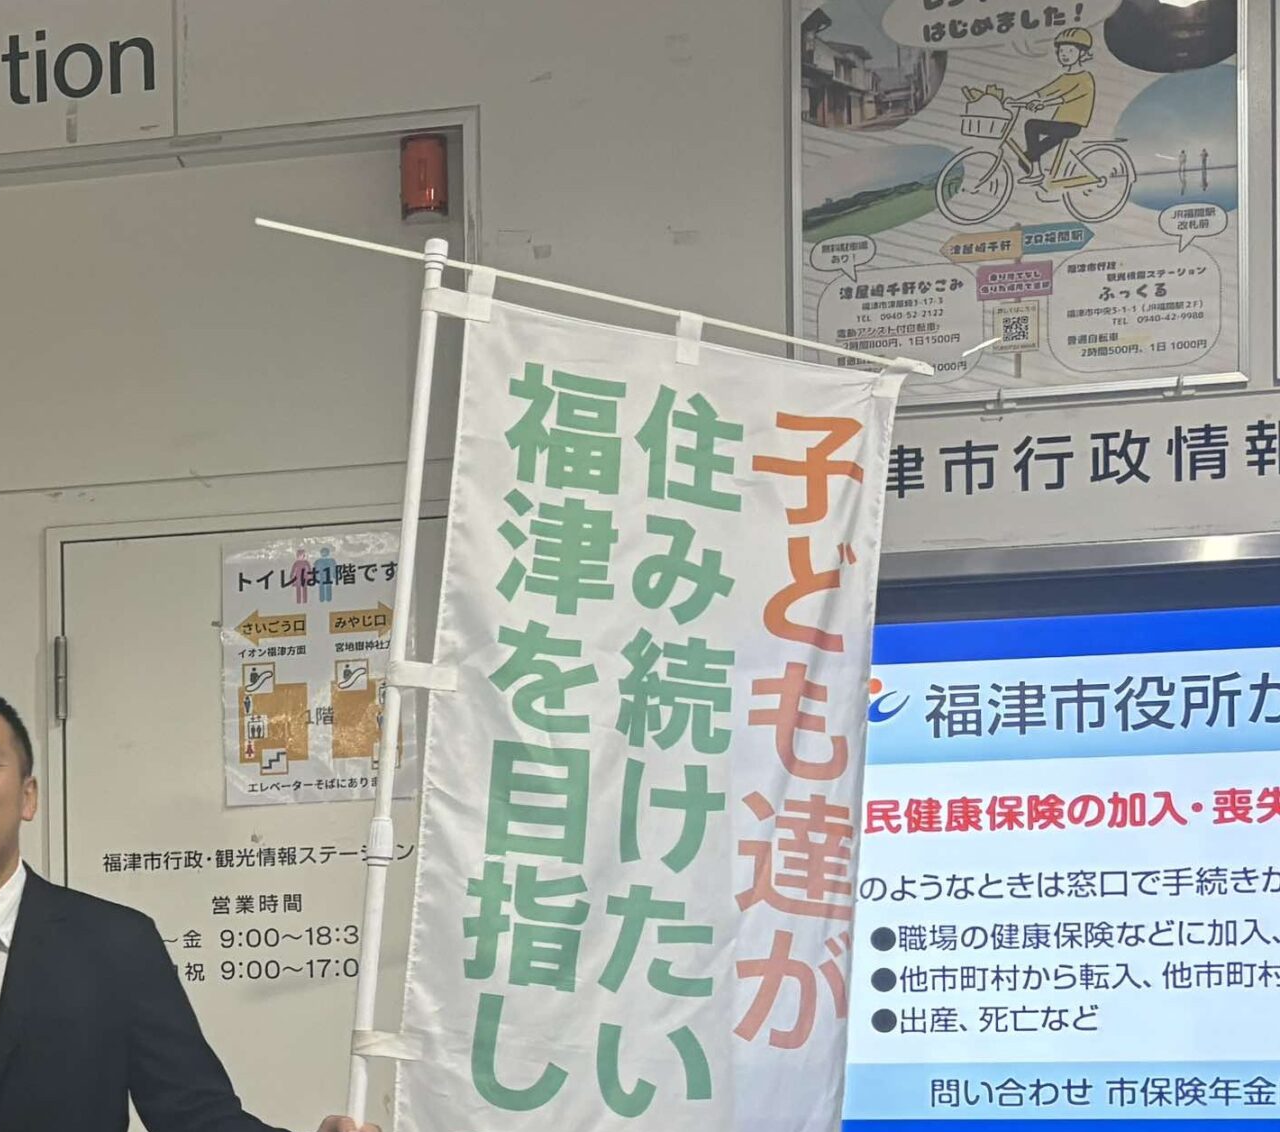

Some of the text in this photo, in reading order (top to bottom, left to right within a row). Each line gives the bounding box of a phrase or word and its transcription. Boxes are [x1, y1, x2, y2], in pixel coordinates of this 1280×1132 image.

[923, 3, 1083, 42] はじめました！
[1099, 283, 1167, 301] ふっくる
[1112, 318, 1128, 326] TEL
[238, 561, 399, 592] トイレは1階です
[242, 619, 305, 635] さいごう口
[334, 614, 386, 628] みやじ口
[238, 645, 306, 659] イオン福津方面
[304, 706, 335, 726] 1階
[733, 412, 864, 1049] 子ども達が
[103, 844, 414, 873] 福津市行政・観光情報ステーン
[212, 894, 303, 915] 営業時間
[931, 1075, 1277, 1107] 問い合わせ 市保険年金
